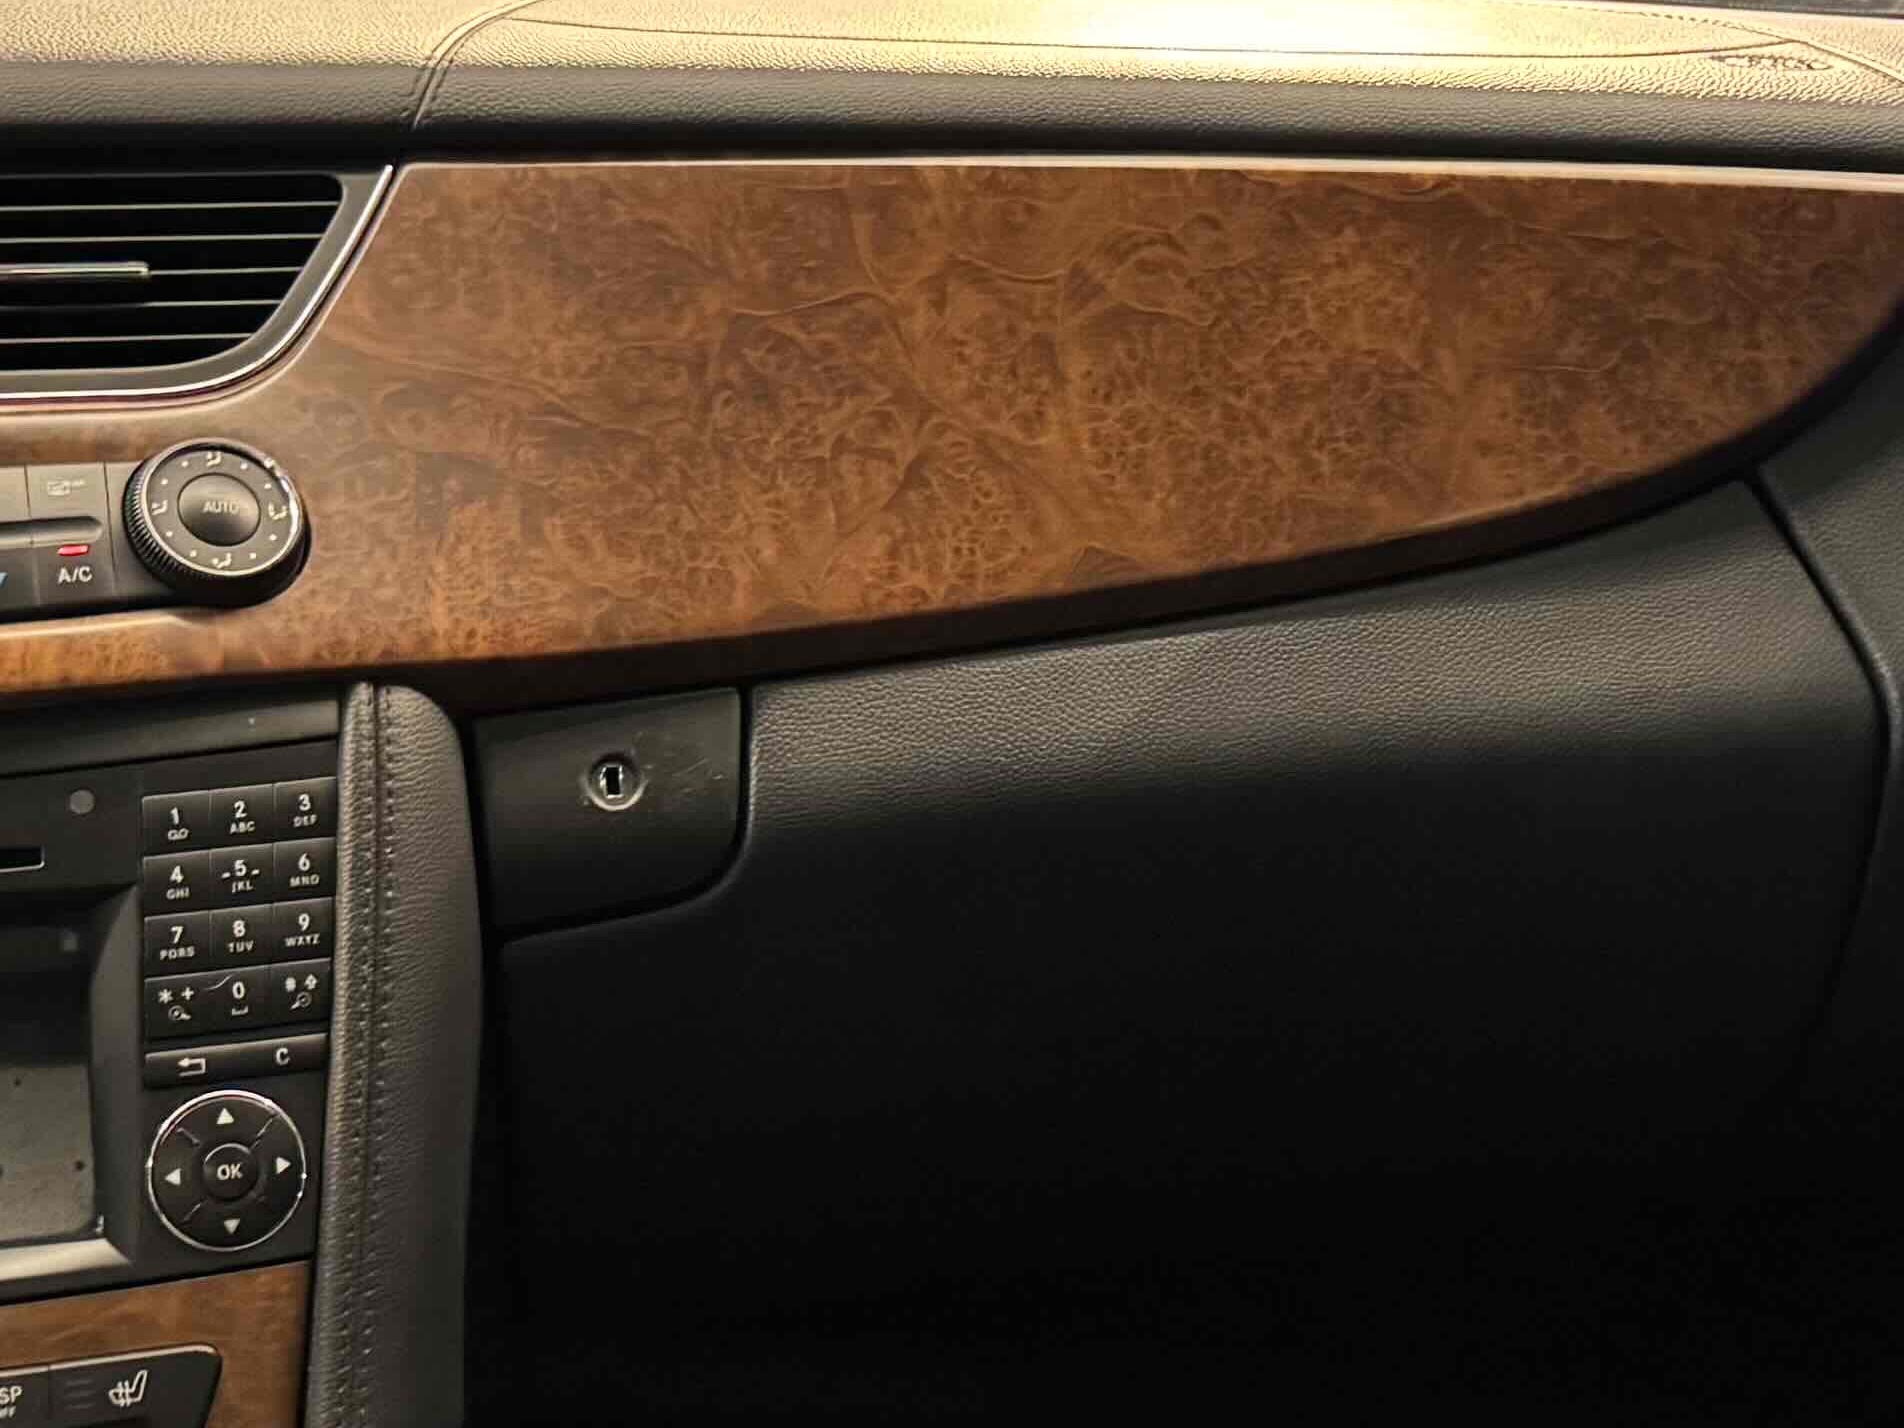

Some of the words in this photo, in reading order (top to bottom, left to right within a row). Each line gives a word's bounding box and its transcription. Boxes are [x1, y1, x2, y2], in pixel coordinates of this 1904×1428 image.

[203, 498, 242, 515] AUTO
[57, 565, 93, 586] A/C
[233, 800, 247, 819] 2
[298, 793, 311, 812] 3
[170, 807, 180, 825] 1
[293, 814, 318, 828] DEF
[230, 820, 256, 834] ABC
[298, 853, 311, 872] 6
[169, 865, 184, 884] 4
[289, 873, 321, 887] MNO
[166, 887, 190, 900] GHI
[231, 880, 254, 893] JKL
[233, 919, 246, 938] 8
[298, 913, 311, 932] 9
[170, 925, 183, 944] 7
[228, 940, 255, 954] TUV
[232, 981, 245, 1000] 0
[275, 1047, 290, 1066] C
[216, 1162, 245, 1181] OK
